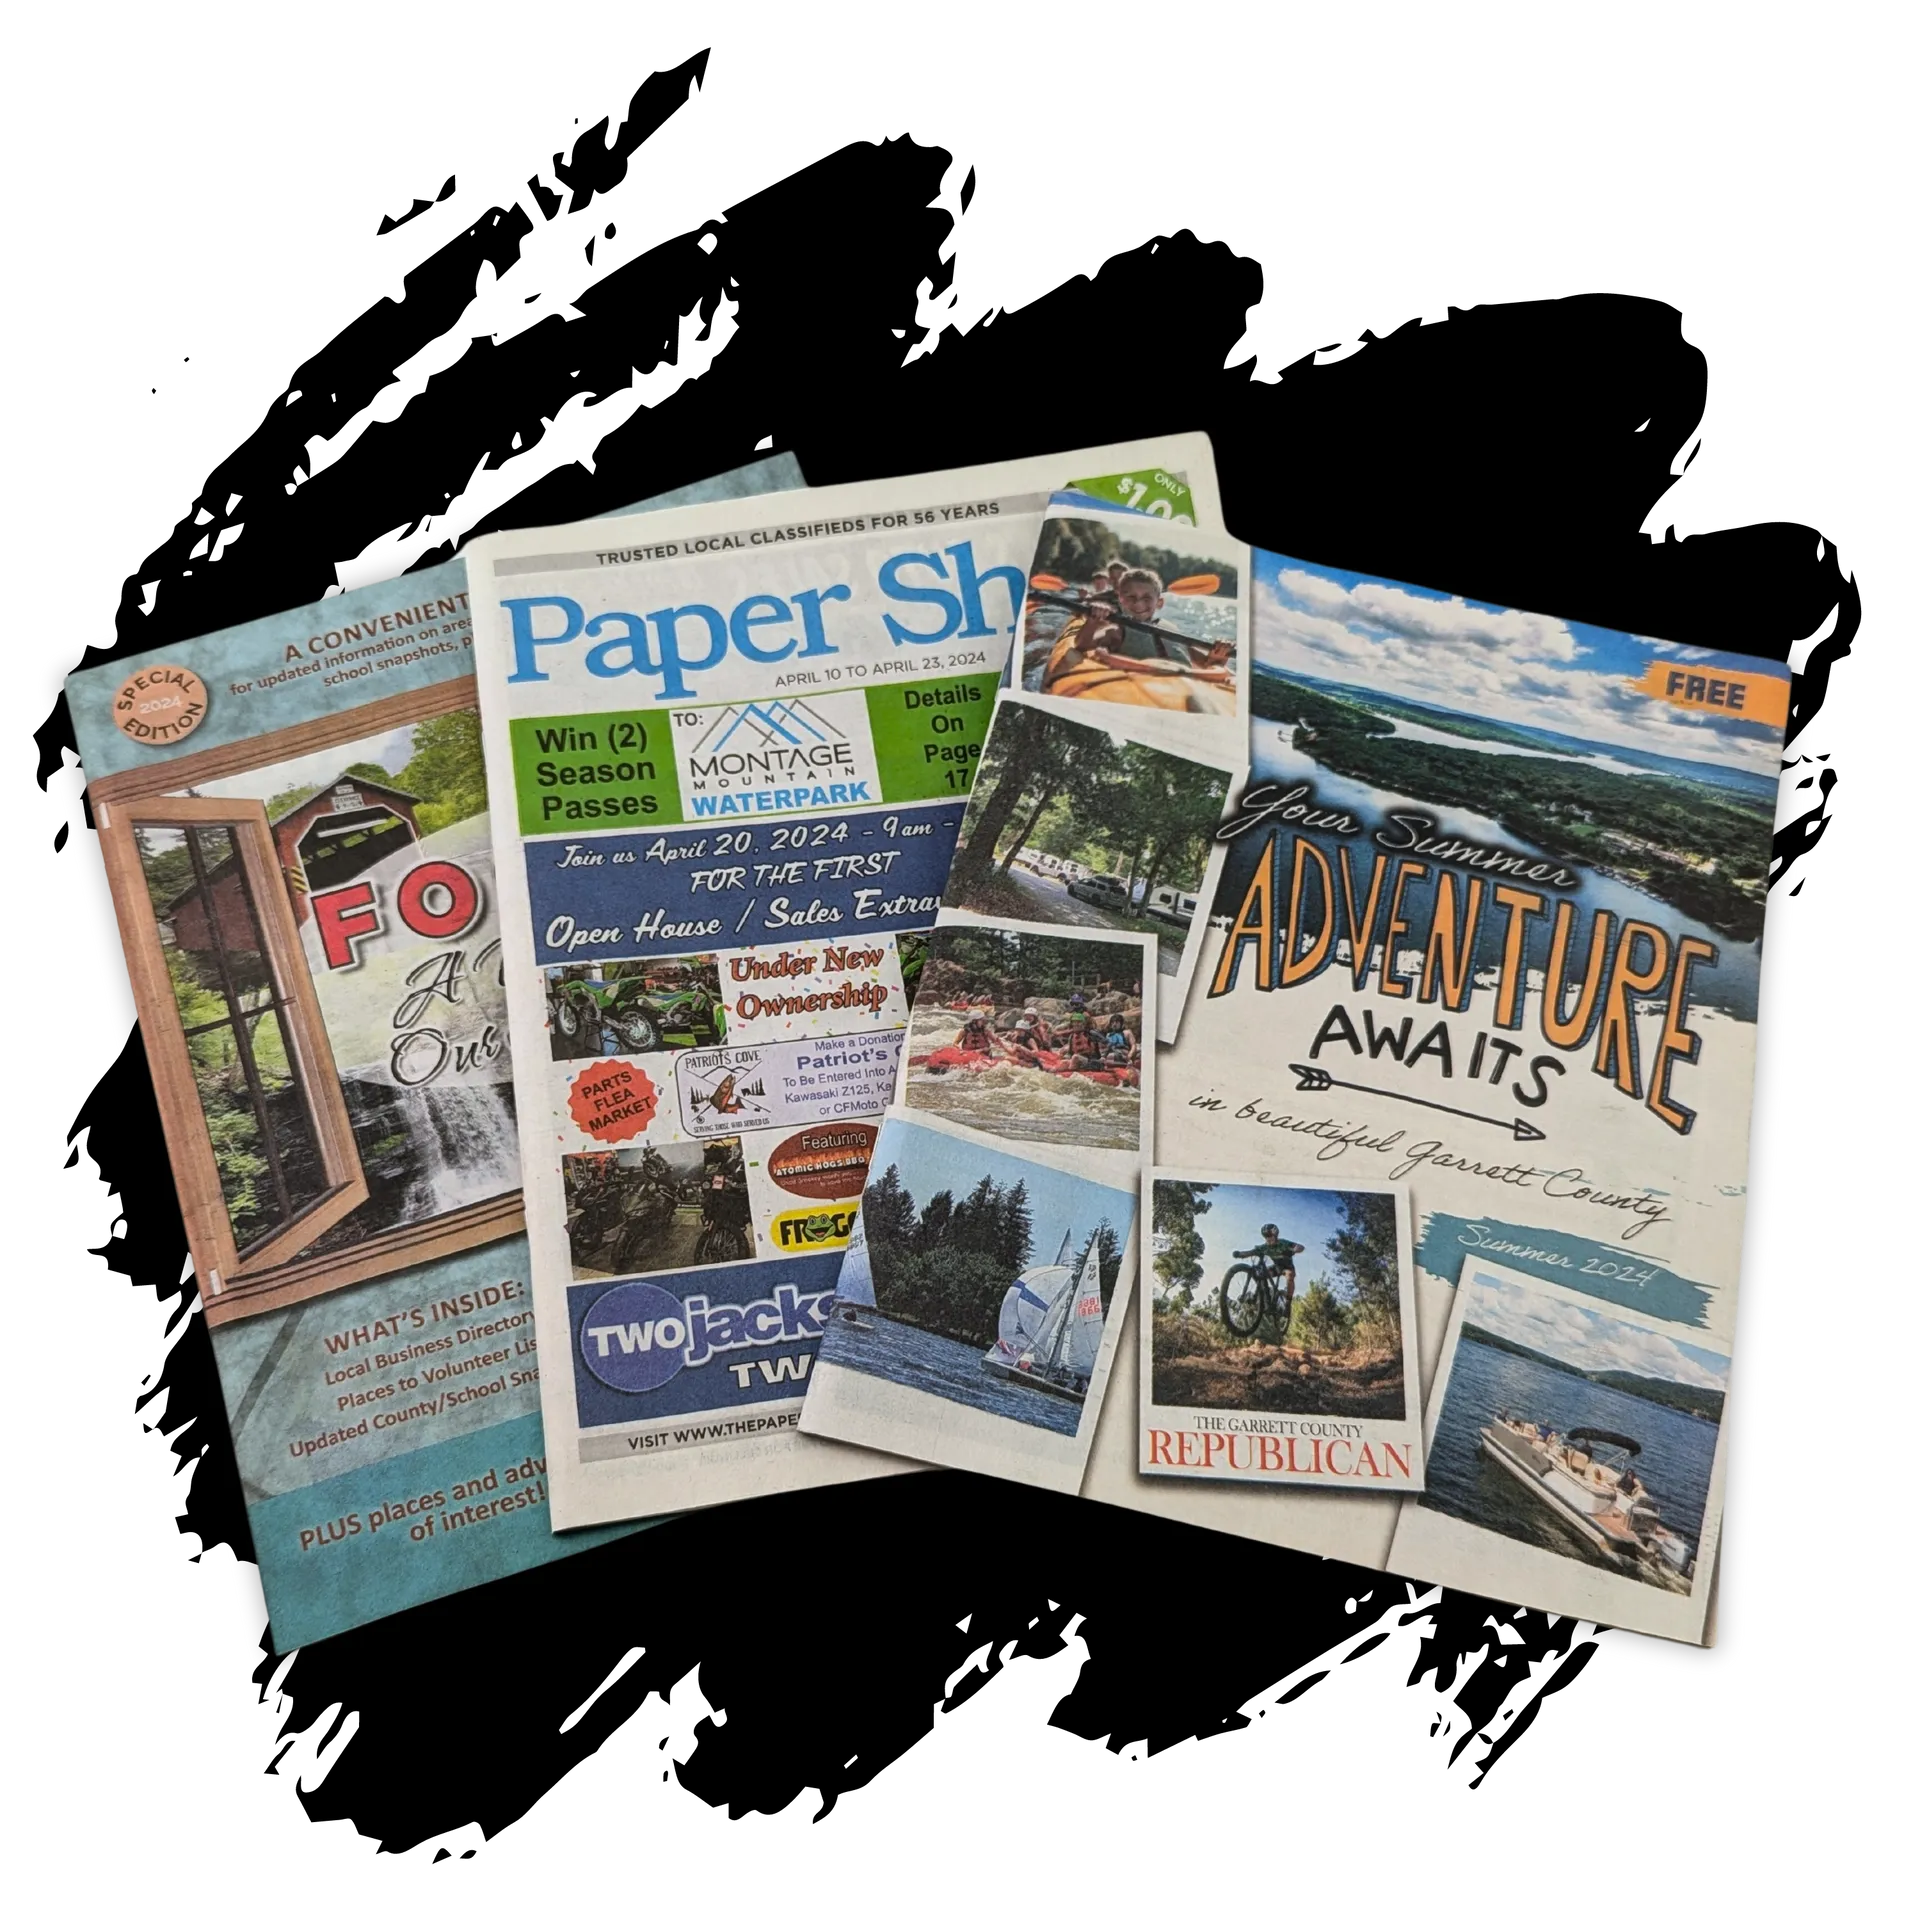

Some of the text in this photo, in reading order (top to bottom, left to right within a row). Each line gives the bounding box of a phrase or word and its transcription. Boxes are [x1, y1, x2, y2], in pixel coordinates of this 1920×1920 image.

[1154, 473, 1186, 497] ONLY
[596, 503, 1000, 566] TRUSTED LOCAL CLASSIFIEDS FOR 56 YEARS
[286, 645, 303, 662] A
[501, 584, 852, 700] Paper
[230, 680, 253, 696] for
[258, 661, 322, 691] updated
[325, 634, 416, 669] information
[419, 627, 439, 640] on
[324, 663, 374, 687] school
[377, 640, 459, 670] snapshots,
[776, 652, 986, 688] APRIL 10 TO APRIL 23, 2024
[117, 670, 196, 711] SPECIAL
[140, 695, 182, 714] 2024
[904, 684, 982, 709] Details
[1665, 671, 1746, 710] FREE
[123, 702, 203, 740] EDITION
[673, 712, 704, 728] TO:
[931, 715, 964, 734] On
[535, 722, 648, 756] Win (2)
[924, 743, 981, 764] Page
[537, 761, 657, 787] Season
[689, 743, 853, 777] MONTAGE
[693, 766, 856, 790] MOUNTAIN
[945, 768, 969, 788] 17
[542, 795, 660, 820] Passes
[691, 781, 871, 816] WATERPARK
[557, 845, 606, 868] Join
[612, 850, 638, 864] us
[645, 838, 708, 865] April
[770, 822, 850, 851] 2024
[882, 815, 933, 838] 9am
[1216, 785, 1575, 887] Your Summer
[690, 851, 902, 893] FOR THE FIRST
[545, 915, 624, 953] Open
[633, 908, 723, 943] House
[764, 897, 845, 929] Sales
[729, 946, 885, 983] Under New
[1206, 829, 1720, 1136] ADVENTURE
[393, 951, 466, 1029] A
[736, 981, 888, 1020] Ownership
[391, 1025, 502, 1086] Our
[797, 1048, 889, 1070] Patriot's
[815, 1040, 845, 1051] Make
[1309, 1004, 1567, 1108] AWAITS
[582, 1071, 632, 1099] PARTS
[783, 1077, 797, 1087] To
[800, 1075, 815, 1086] Be
[818, 1069, 862, 1084] Entered
[865, 1067, 886, 1078] Into
[785, 1087, 839, 1104] Kawasaki
[842, 1083, 874, 1097] Z125,
[589, 1097, 652, 1131] MARKET
[594, 1088, 635, 1112] FLEA
[819, 1106, 831, 1116] or
[833, 1099, 879, 1114] CFMoto
[801, 1132, 868, 1151] Featuring
[776, 1164, 814, 1177] ATOMIC
[815, 1159, 843, 1171] HOGS
[1189, 1089, 1673, 1241] in beautiful Garrett County
[1458, 1224, 1661, 1287] Summer 2024
[325, 1281, 525, 1356] WHAT'S INSIDE:
[588, 1317, 687, 1358] TWO
[326, 1358, 371, 1386] Local
[375, 1336, 453, 1370] Business
[337, 1387, 396, 1412] Places
[399, 1378, 419, 1395] to
[422, 1347, 510, 1384] Volunteer
[289, 1419, 369, 1458] Updated
[373, 1375, 507, 1431] County/School
[1193, 1415, 1364, 1438] THE GARRETT COUNTY
[628, 1432, 669, 1451] VISIT
[1148, 1429, 1412, 1479] REPUBLICAN
[300, 1513, 362, 1551] PLUS
[369, 1490, 446, 1533] places
[453, 1469, 499, 1500] and
[410, 1480, 546, 1541] of interest!
